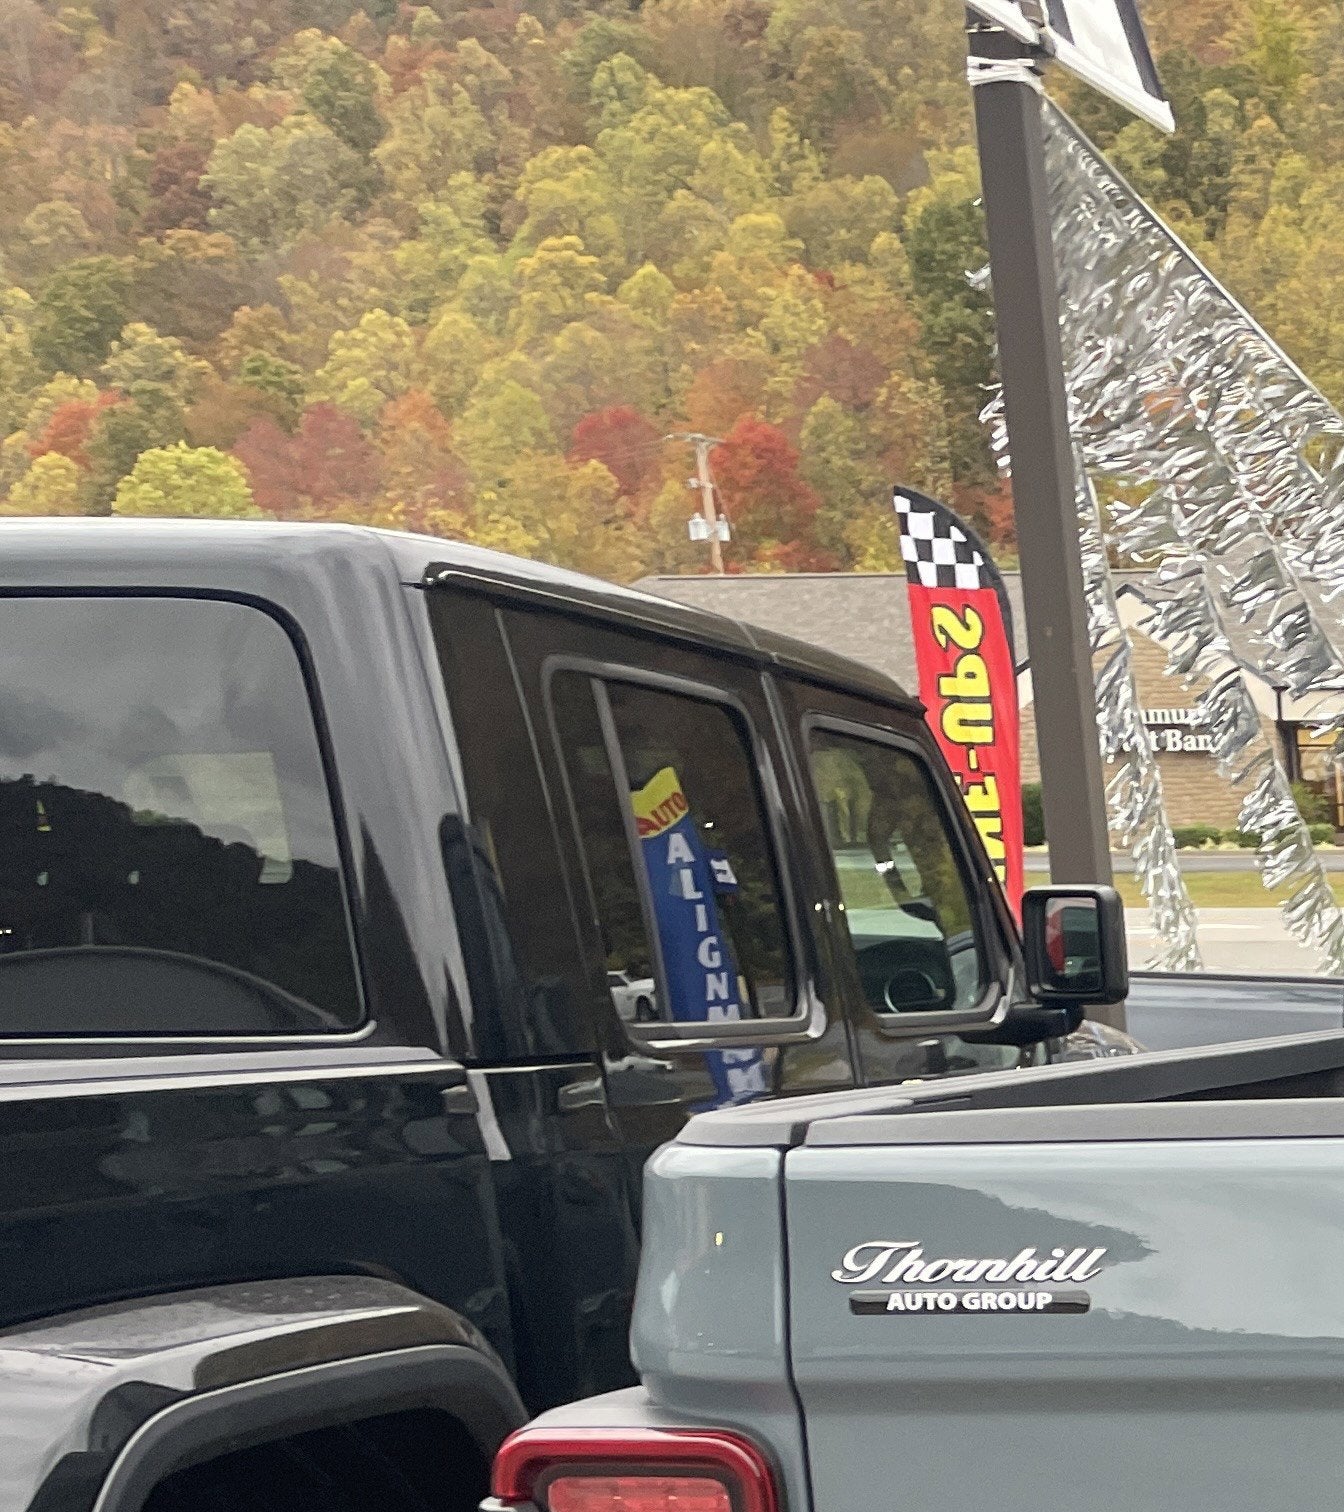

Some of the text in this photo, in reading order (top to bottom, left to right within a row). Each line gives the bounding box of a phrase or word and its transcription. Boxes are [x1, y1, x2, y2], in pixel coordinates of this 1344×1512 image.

[1164, 729, 1213, 752] Ban
[636, 791, 687, 836] AUTO
[830, 1240, 1108, 1284] Thornhill
[886, 1291, 1053, 1312] AUTO GROUP
